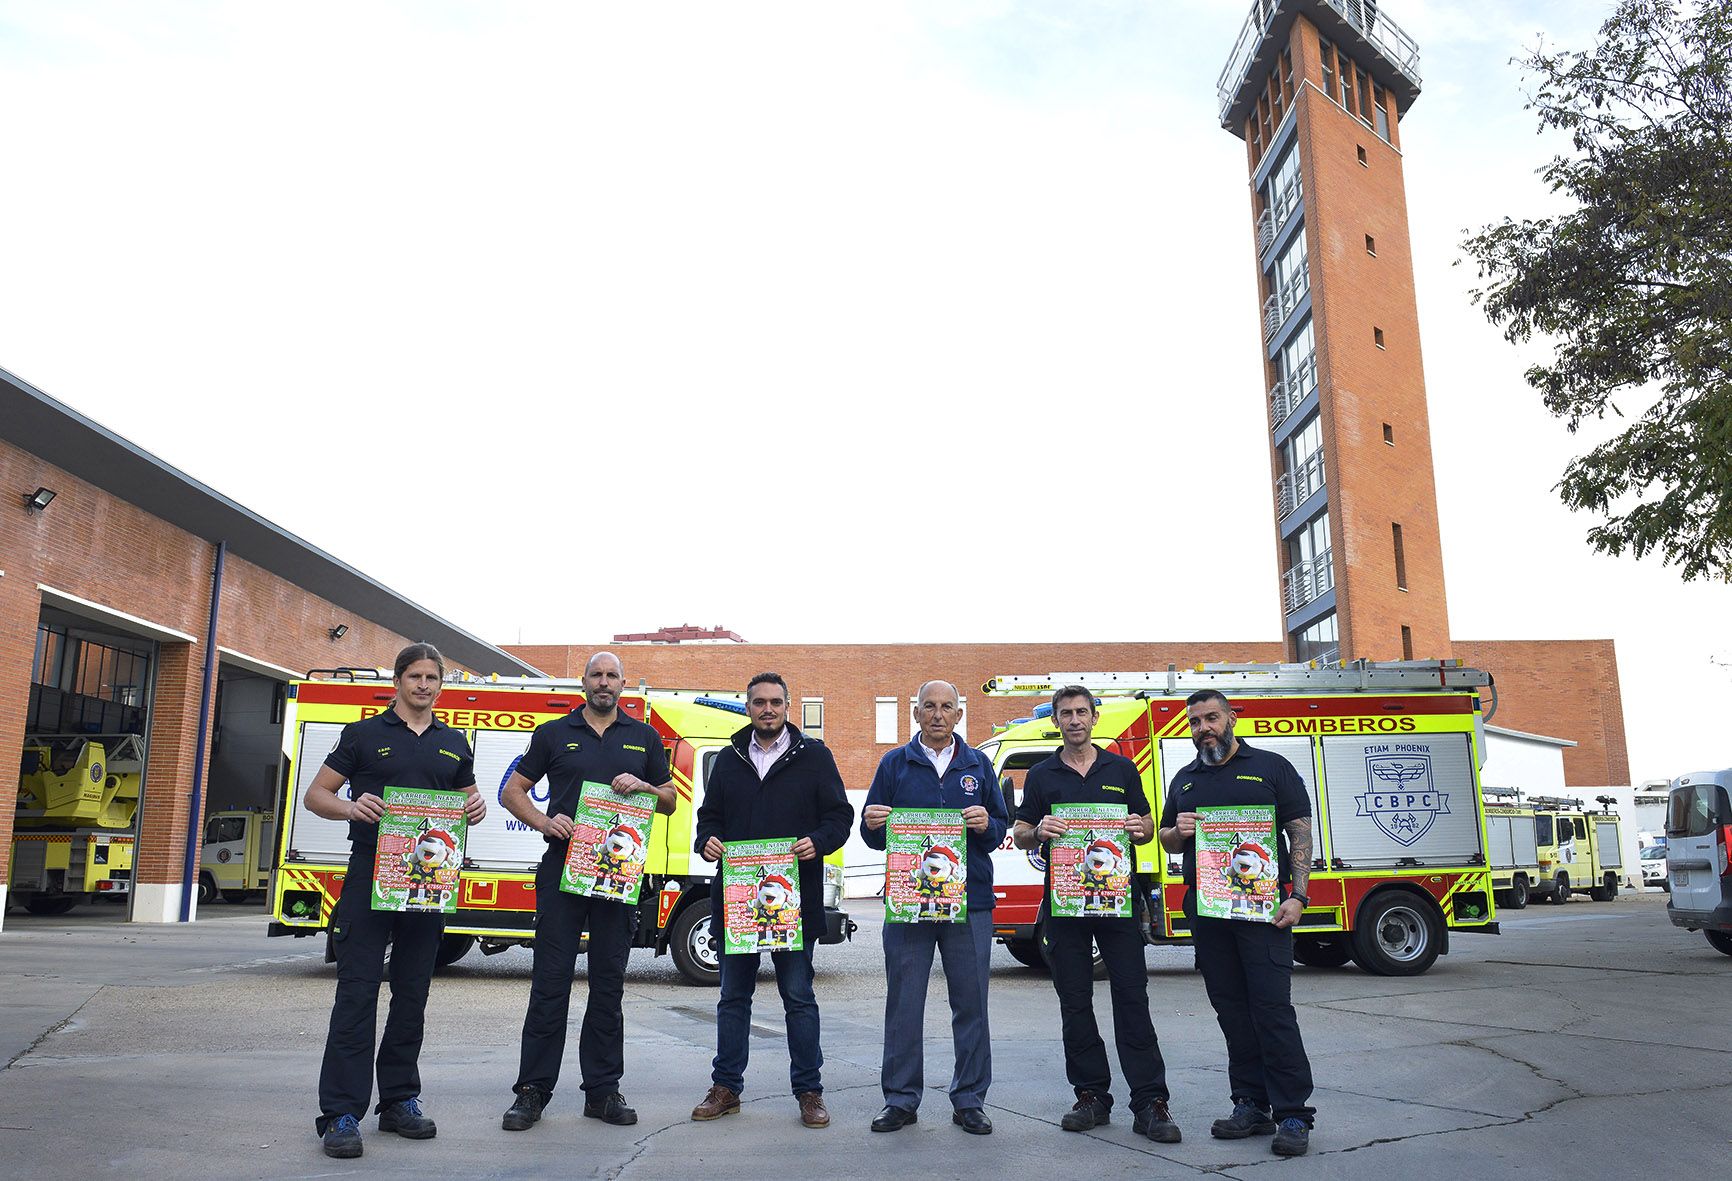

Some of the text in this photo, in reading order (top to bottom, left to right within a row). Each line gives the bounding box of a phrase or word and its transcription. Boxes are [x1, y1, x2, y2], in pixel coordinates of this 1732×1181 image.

[360, 707, 536, 729] BBEROS
[1254, 717, 1416, 734] BOMBEROS
[439, 748, 461, 762] BOMBEROS
[1364, 744, 1430, 755] ETIAM PHOENIX
[417, 818, 430, 833] 4
[608, 812, 621, 828] 4
[921, 836, 931, 850] 4
[1084, 830, 1094, 844] 4
[1230, 833, 1240, 847] 4
[756, 865, 766, 880] 4
